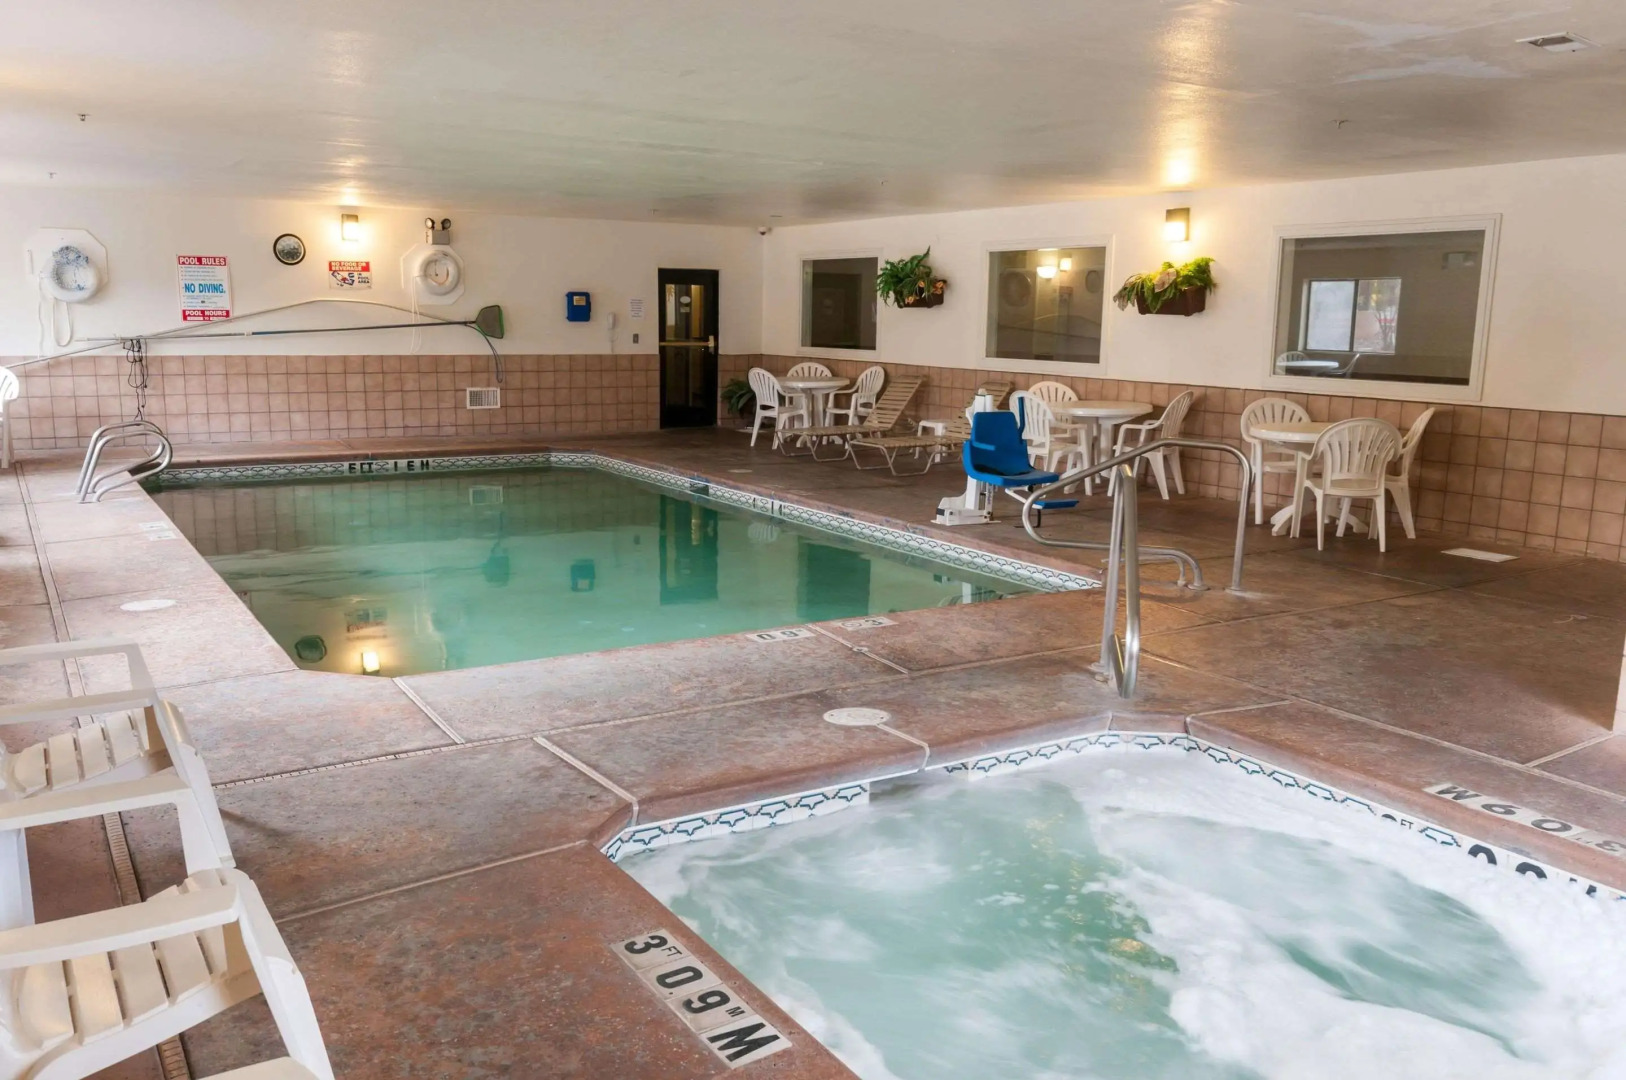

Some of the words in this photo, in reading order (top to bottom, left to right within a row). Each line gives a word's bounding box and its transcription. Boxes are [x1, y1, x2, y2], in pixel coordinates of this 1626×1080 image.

[180, 257, 200, 265] POOL
[202, 257, 225, 266] RULES
[184, 283, 196, 293] NO
[198, 283, 226, 294] DIVING.
[706, 1022, 781, 1063] M
